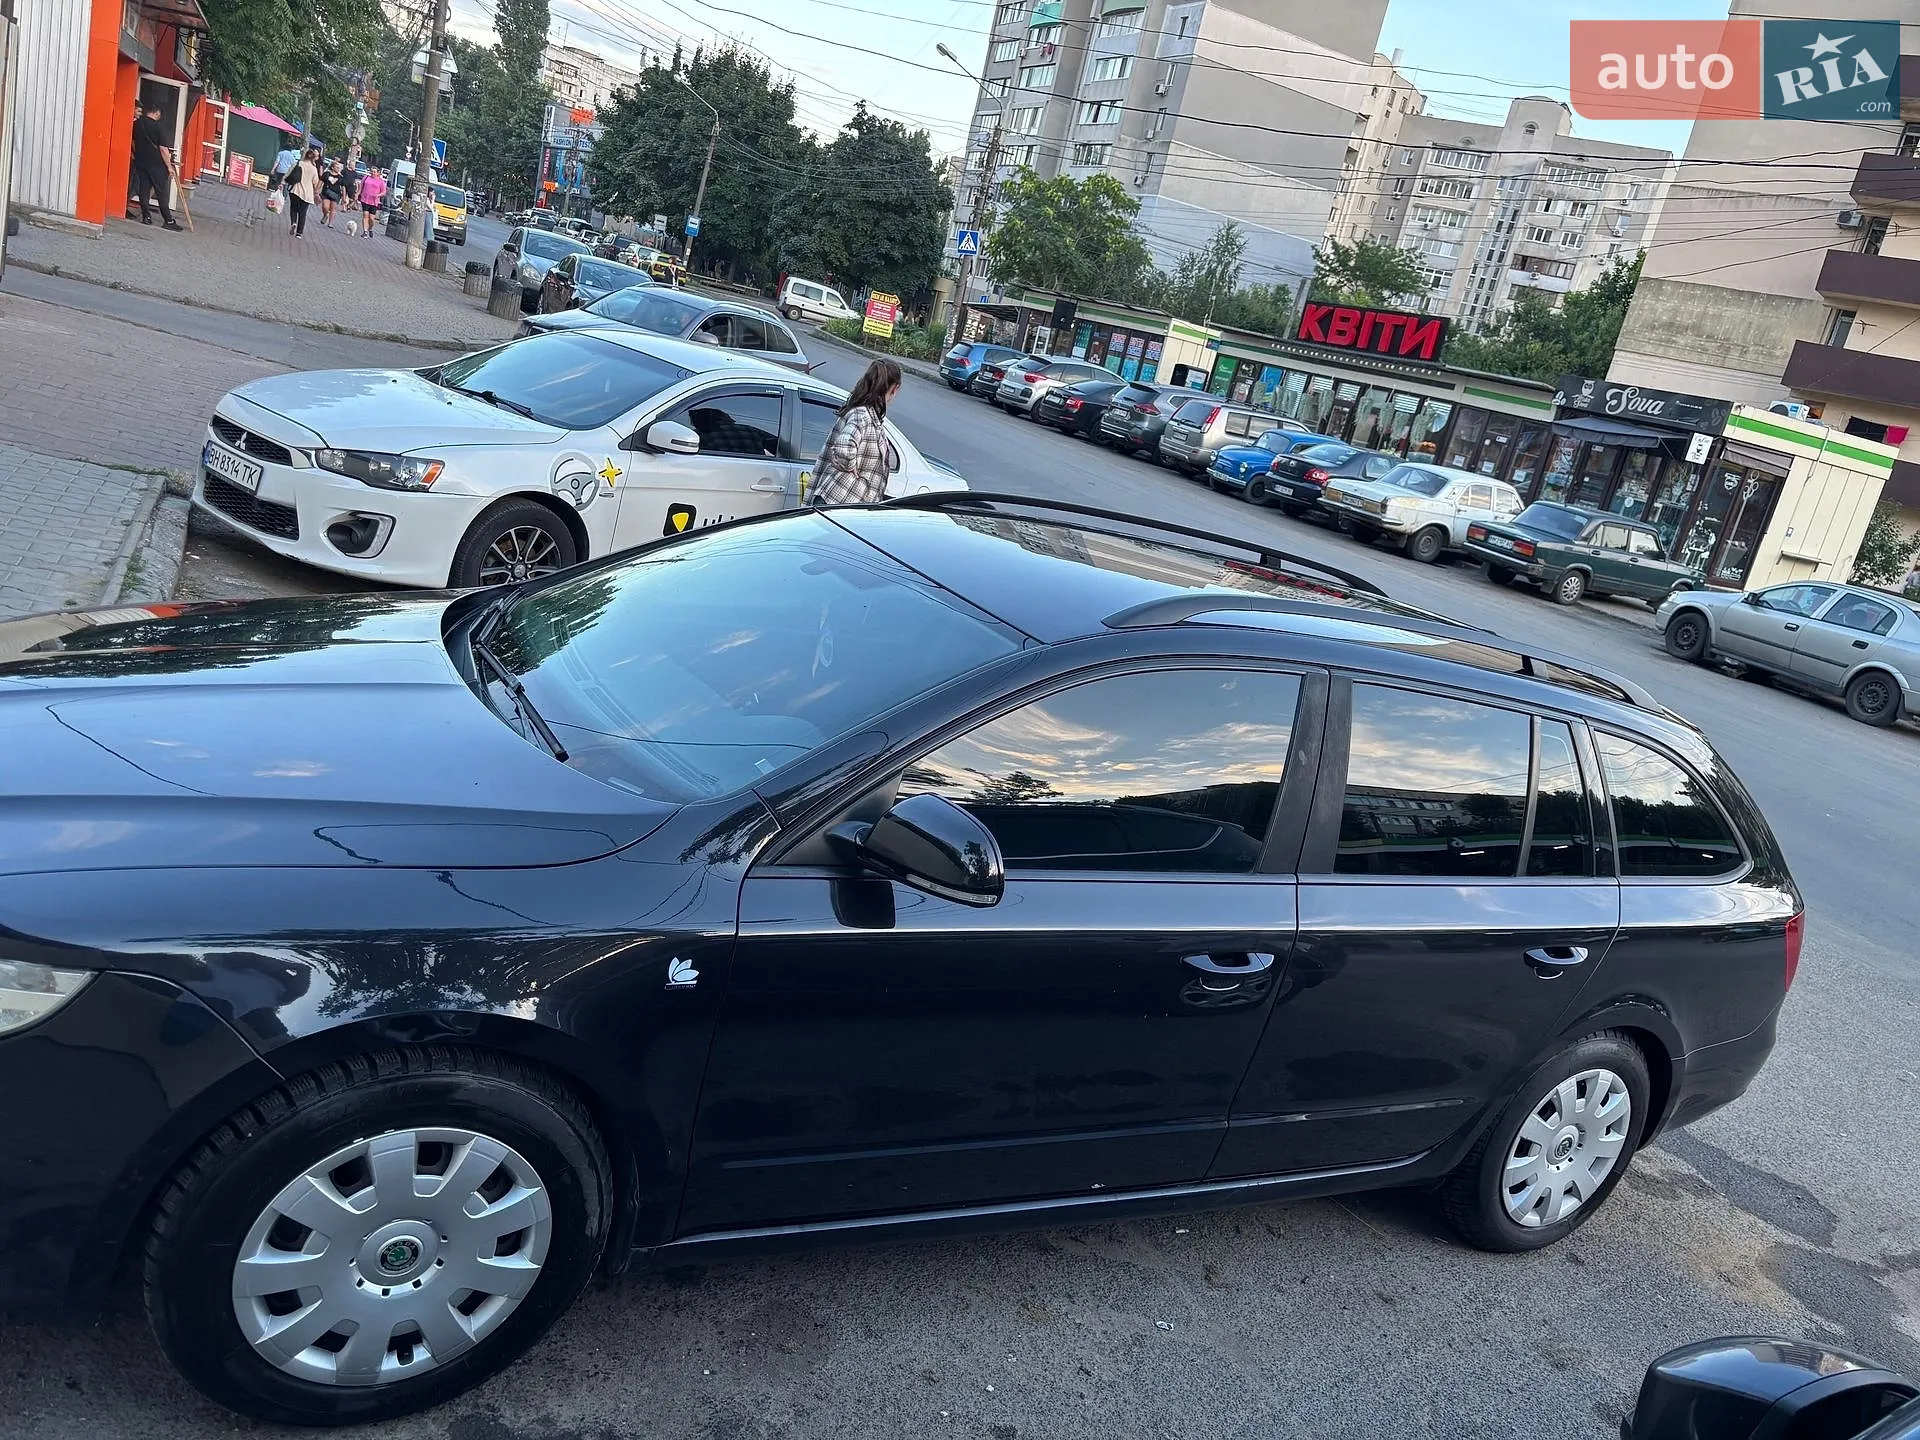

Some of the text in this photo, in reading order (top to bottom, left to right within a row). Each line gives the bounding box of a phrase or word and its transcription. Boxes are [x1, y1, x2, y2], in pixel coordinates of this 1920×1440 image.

[1298, 303, 1441, 359] КВІТИ
[1605, 386, 1665, 415] Sova
[208, 448, 257, 486] BH 8314 TK
